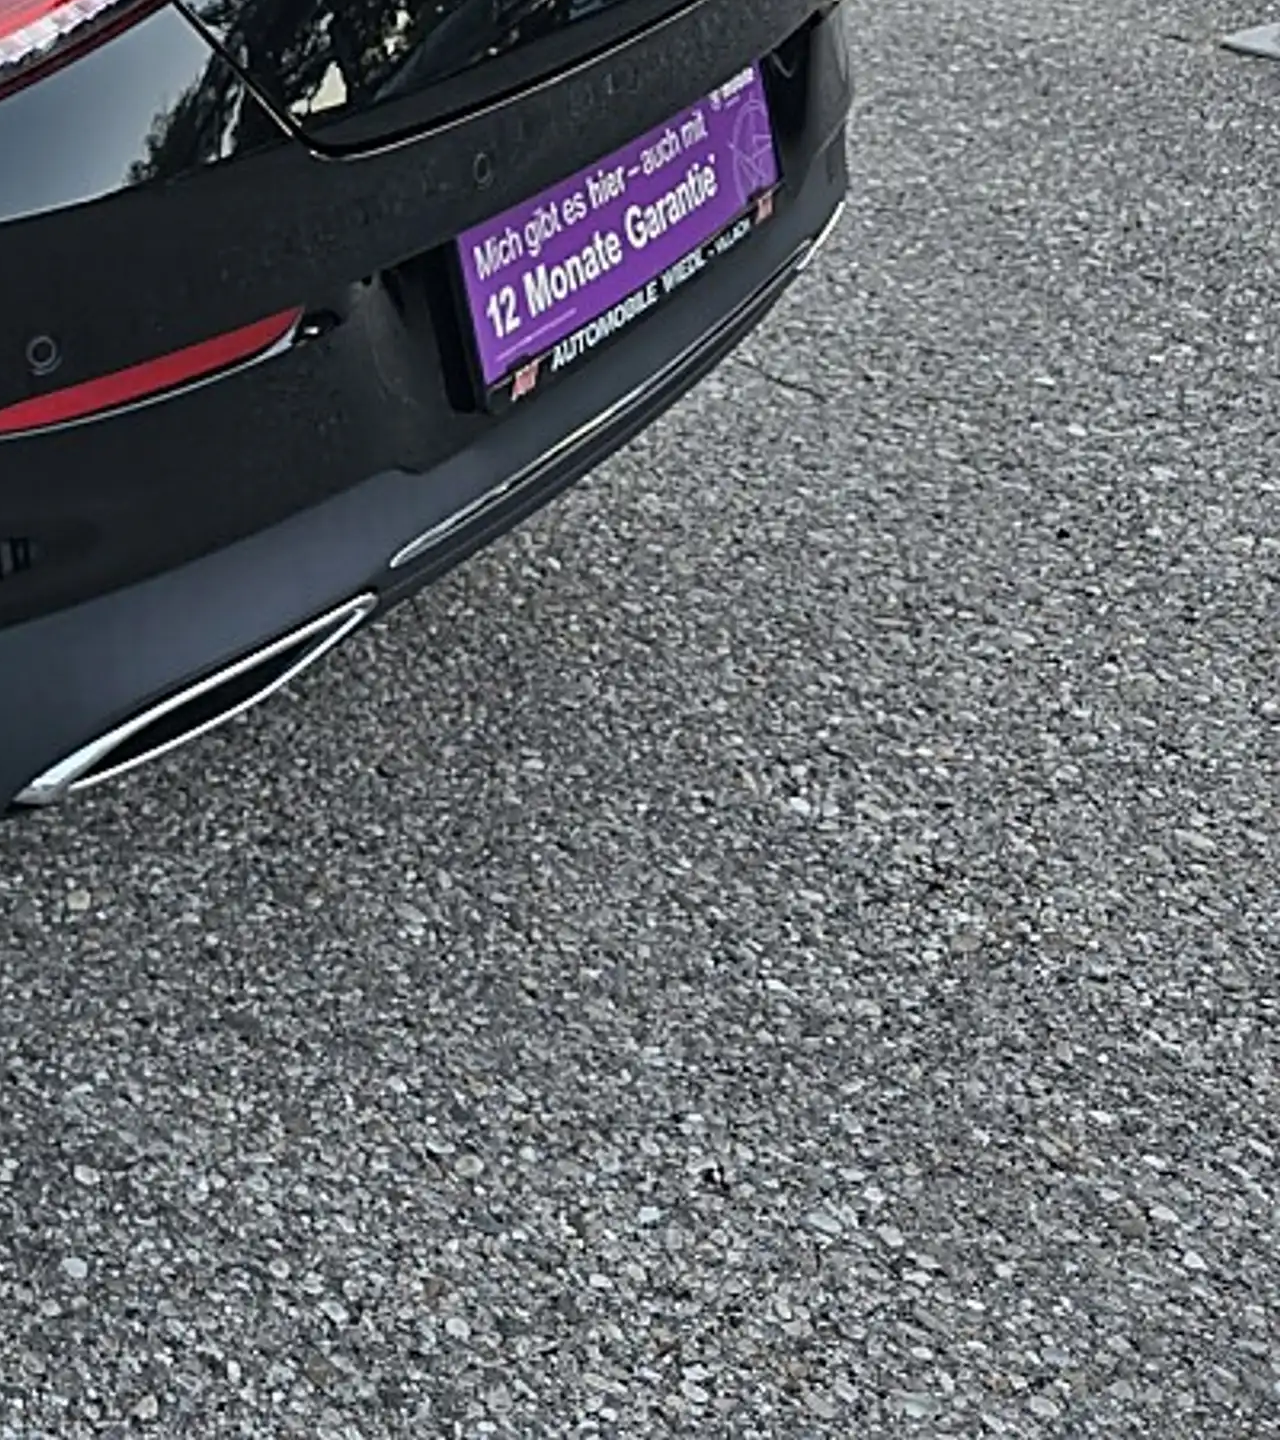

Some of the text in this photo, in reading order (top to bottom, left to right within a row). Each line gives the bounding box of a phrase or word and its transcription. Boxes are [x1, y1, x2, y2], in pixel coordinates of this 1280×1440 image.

[473, 226, 523, 280] Mich
[524, 201, 562, 257] gibt
[562, 191, 587, 225] es
[585, 165, 625, 209] hier
[640, 128, 681, 175] auch
[681, 108, 708, 149] mit
[486, 285, 520, 338] 12
[522, 230, 623, 318] Monate
[551, 280, 660, 372] AUTOMOBILE
